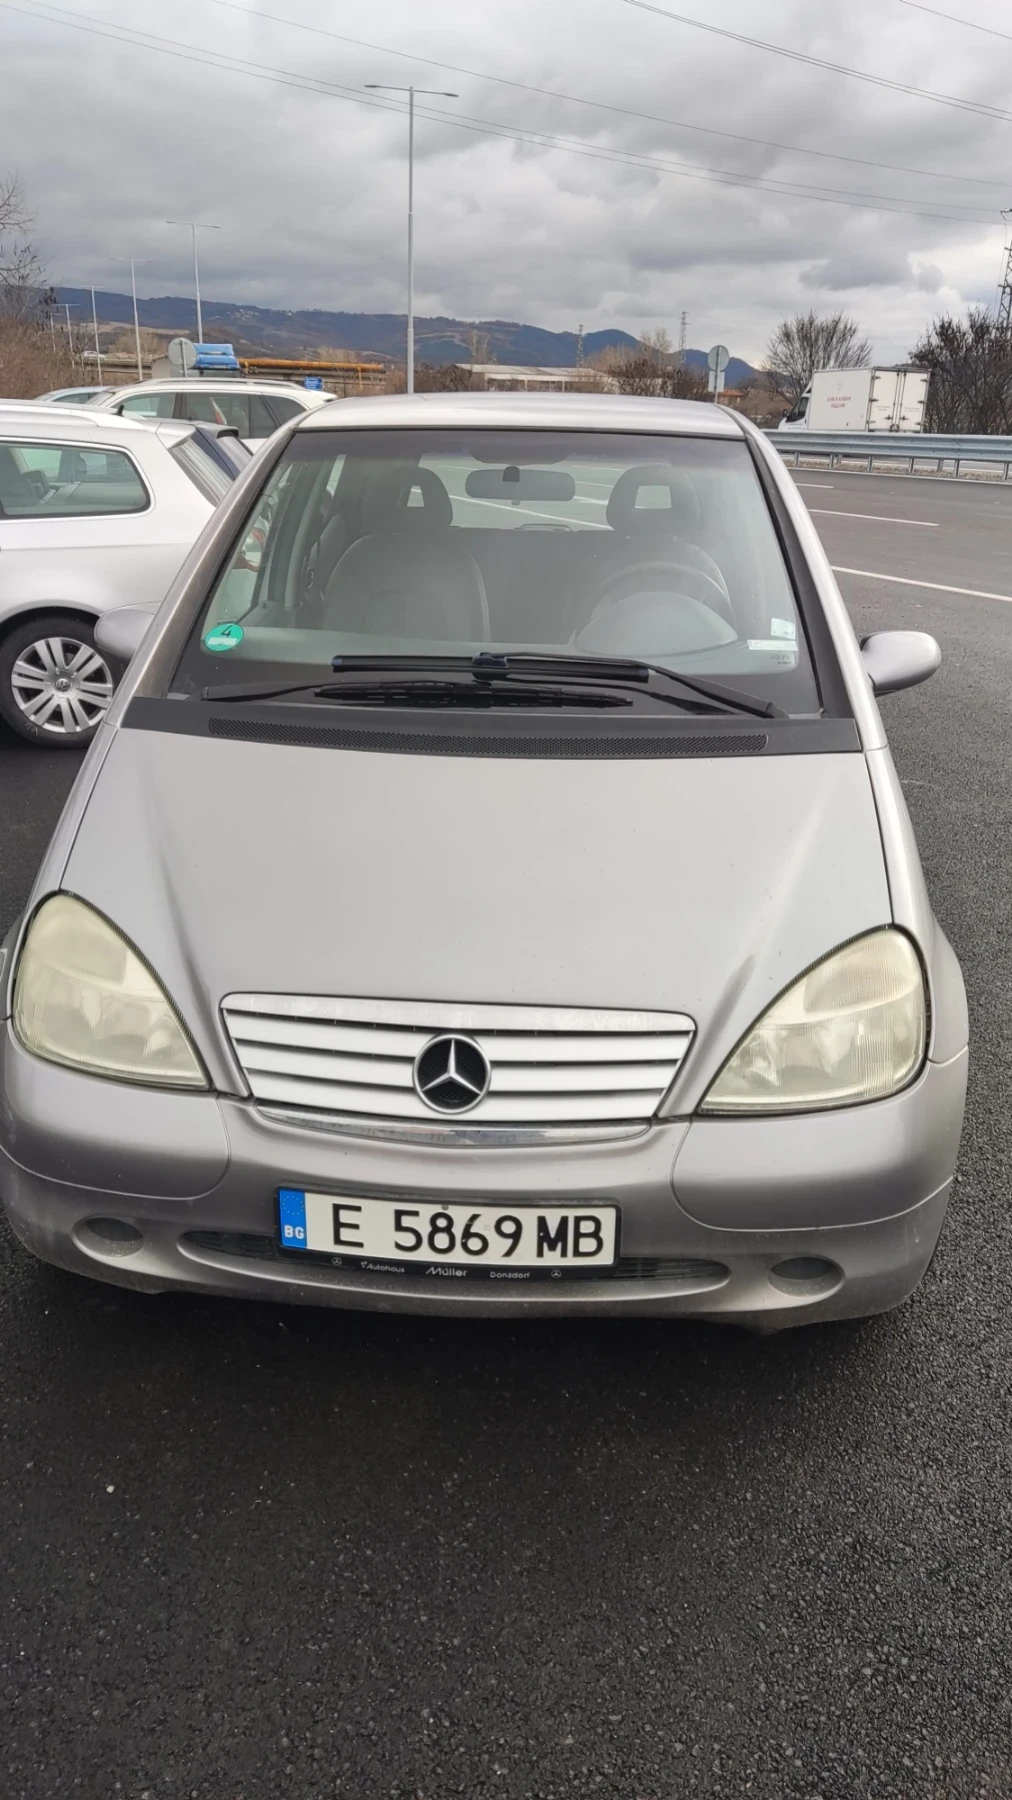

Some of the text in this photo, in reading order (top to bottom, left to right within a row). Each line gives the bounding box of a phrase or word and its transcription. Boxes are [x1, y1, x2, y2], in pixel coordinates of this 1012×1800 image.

[220, 624, 233, 638] 4
[283, 1225, 305, 1240] BG
[332, 1203, 604, 1259] E 5869 MB
[366, 1262, 406, 1274] Autohaus
[425, 1266, 468, 1279] Müller
